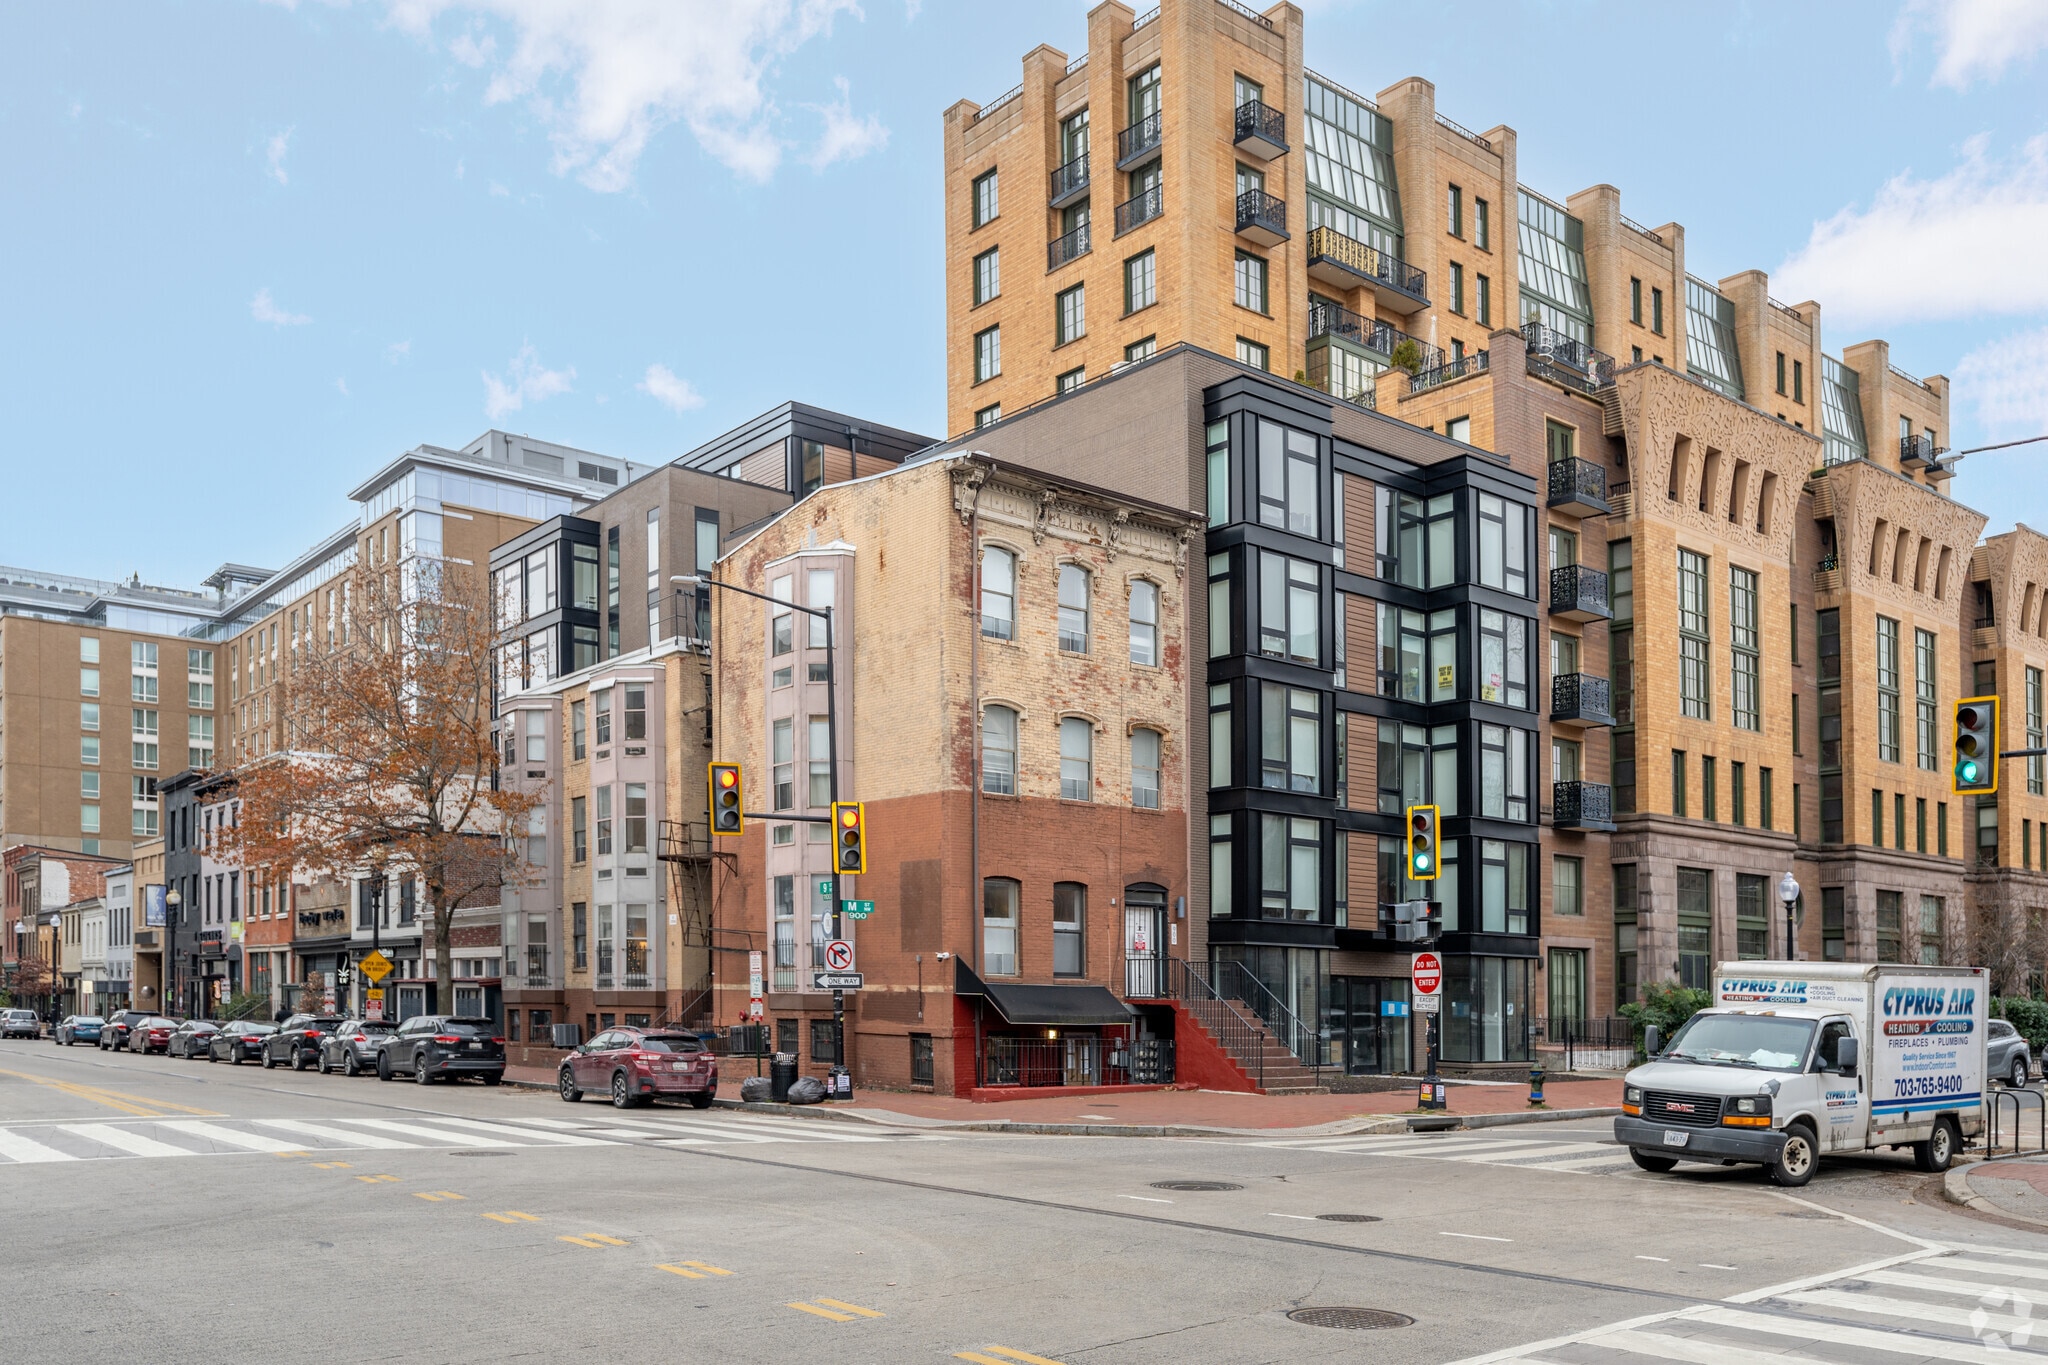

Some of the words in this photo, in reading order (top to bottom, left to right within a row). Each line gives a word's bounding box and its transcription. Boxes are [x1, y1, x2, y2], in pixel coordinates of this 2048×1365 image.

[848, 901, 857, 912] M
[1722, 979, 1777, 992] CYPRUS
[1781, 981, 1808, 994] AIR
[1883, 987, 1946, 1016] CYPRUS
[1947, 988, 1975, 1015] AIR
[1888, 1024, 1919, 1034] HEATING
[1926, 1023, 1930, 1032] &
[1936, 1022, 1967, 1032] COOLING
[1889, 1038, 1928, 1048] FIREPLACES
[1938, 1036, 1968, 1046] PLUMBING
[1903, 1053, 1918, 1062] Quality
[1894, 1075, 1962, 1097] 703-765-9400
[1826, 1091, 1846, 1100] CYPRUS
[1666, 1102, 1695, 1112] GMC
